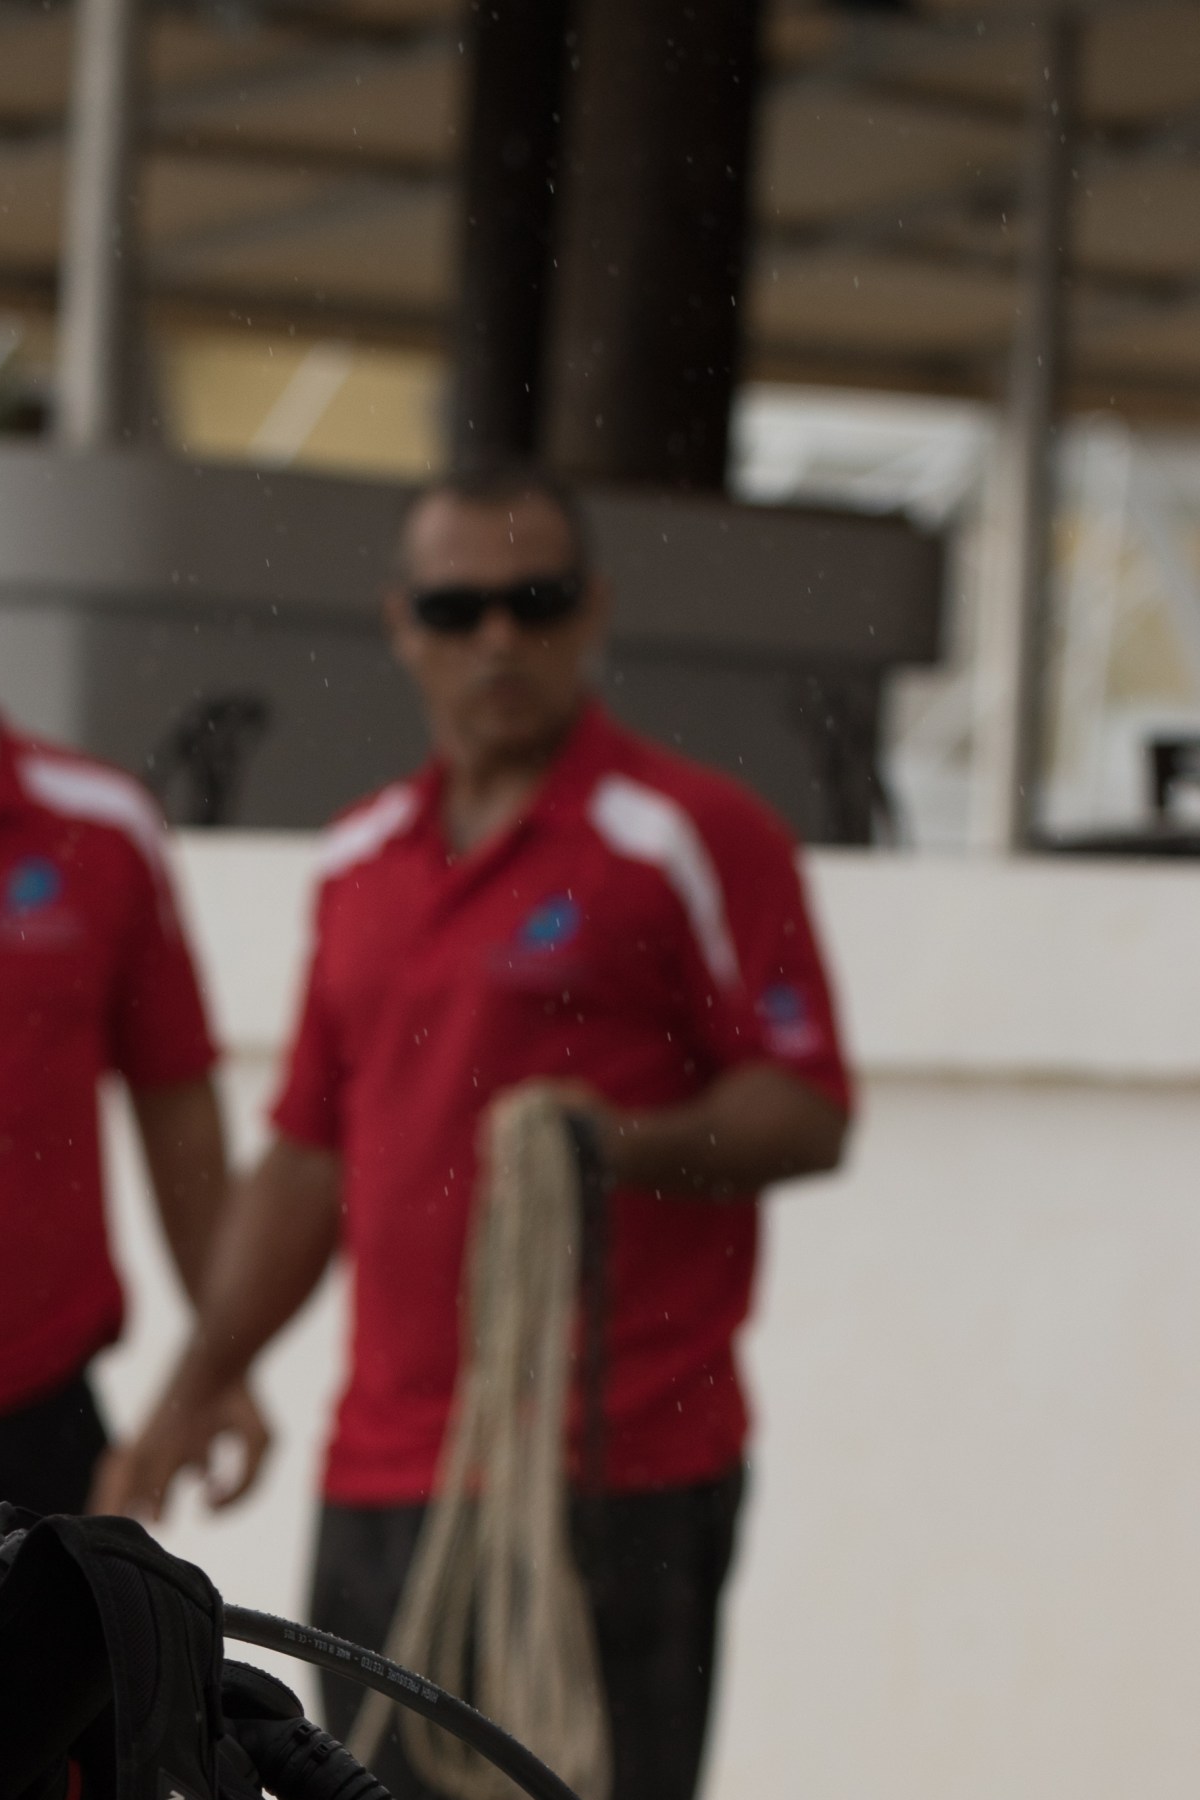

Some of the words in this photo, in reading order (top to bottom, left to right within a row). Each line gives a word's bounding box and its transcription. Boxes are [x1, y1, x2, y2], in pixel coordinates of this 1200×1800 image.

[360, 1656, 386, 1678] TESTED
[387, 1667, 422, 1694] PRESSURE
[421, 1688, 440, 1704] HIGH
